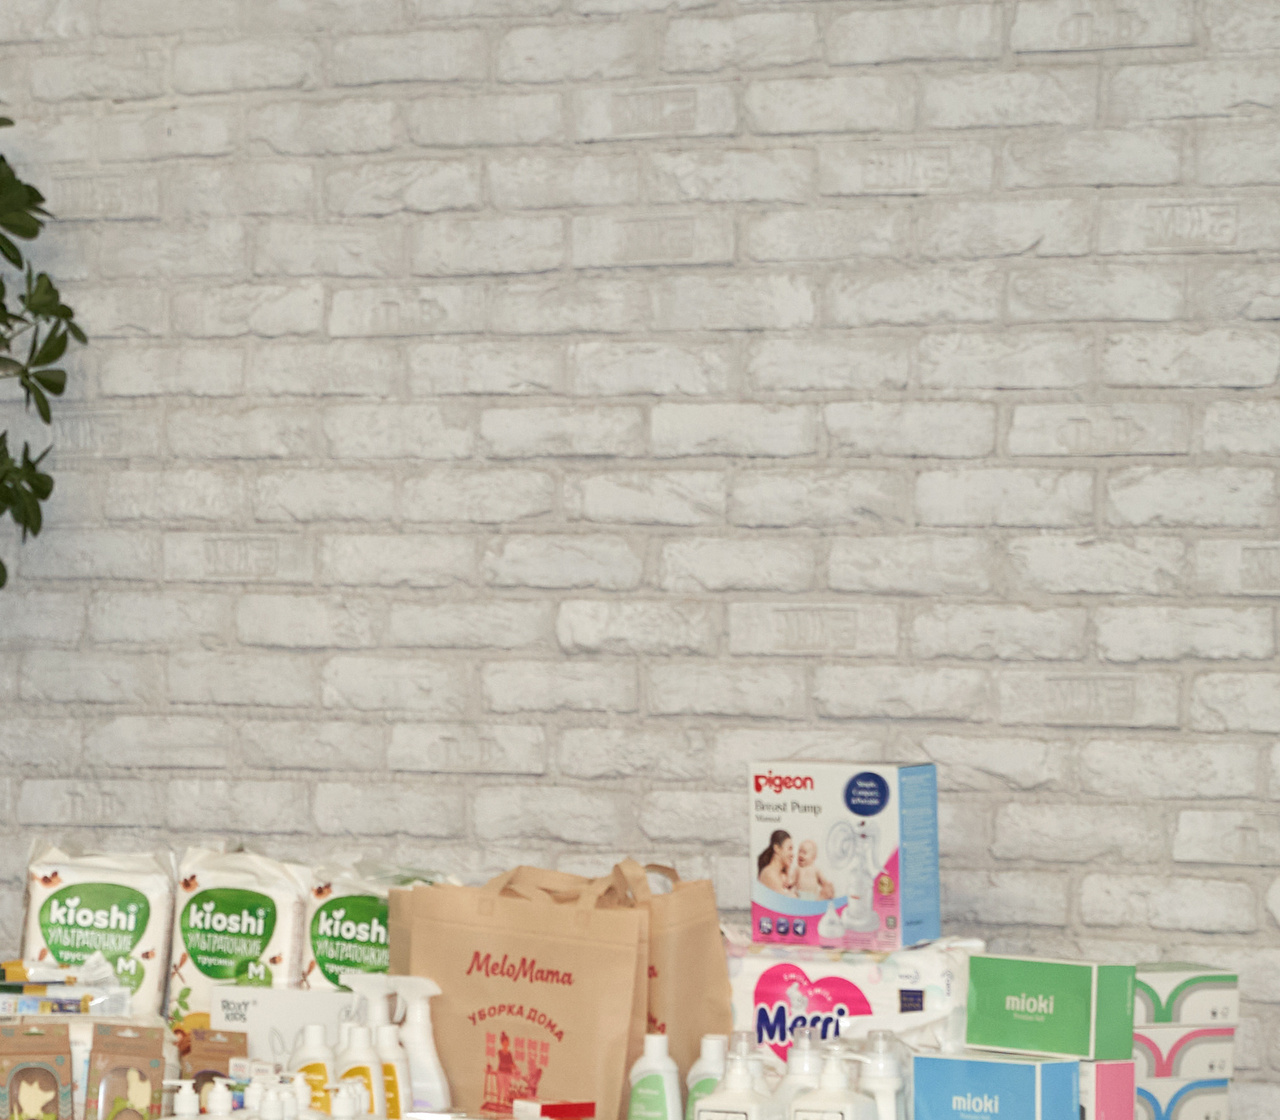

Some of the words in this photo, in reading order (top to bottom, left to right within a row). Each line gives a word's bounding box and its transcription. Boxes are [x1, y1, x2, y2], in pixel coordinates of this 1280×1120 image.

[754, 770, 814, 794] pigeon
[49, 896, 138, 931] kioshi
[189, 900, 266, 936] kioshi
[318, 908, 390, 944] kiosh
[116, 956, 137, 976] M
[248, 961, 266, 980] M
[466, 950, 573, 985] MeloMama
[221, 999, 250, 1012] ROXY
[1005, 992, 1055, 1014] mioki
[467, 1004, 524, 1026] УБОРКА
[526, 1007, 564, 1042] ДОМА
[952, 1092, 1000, 1114] mioki
